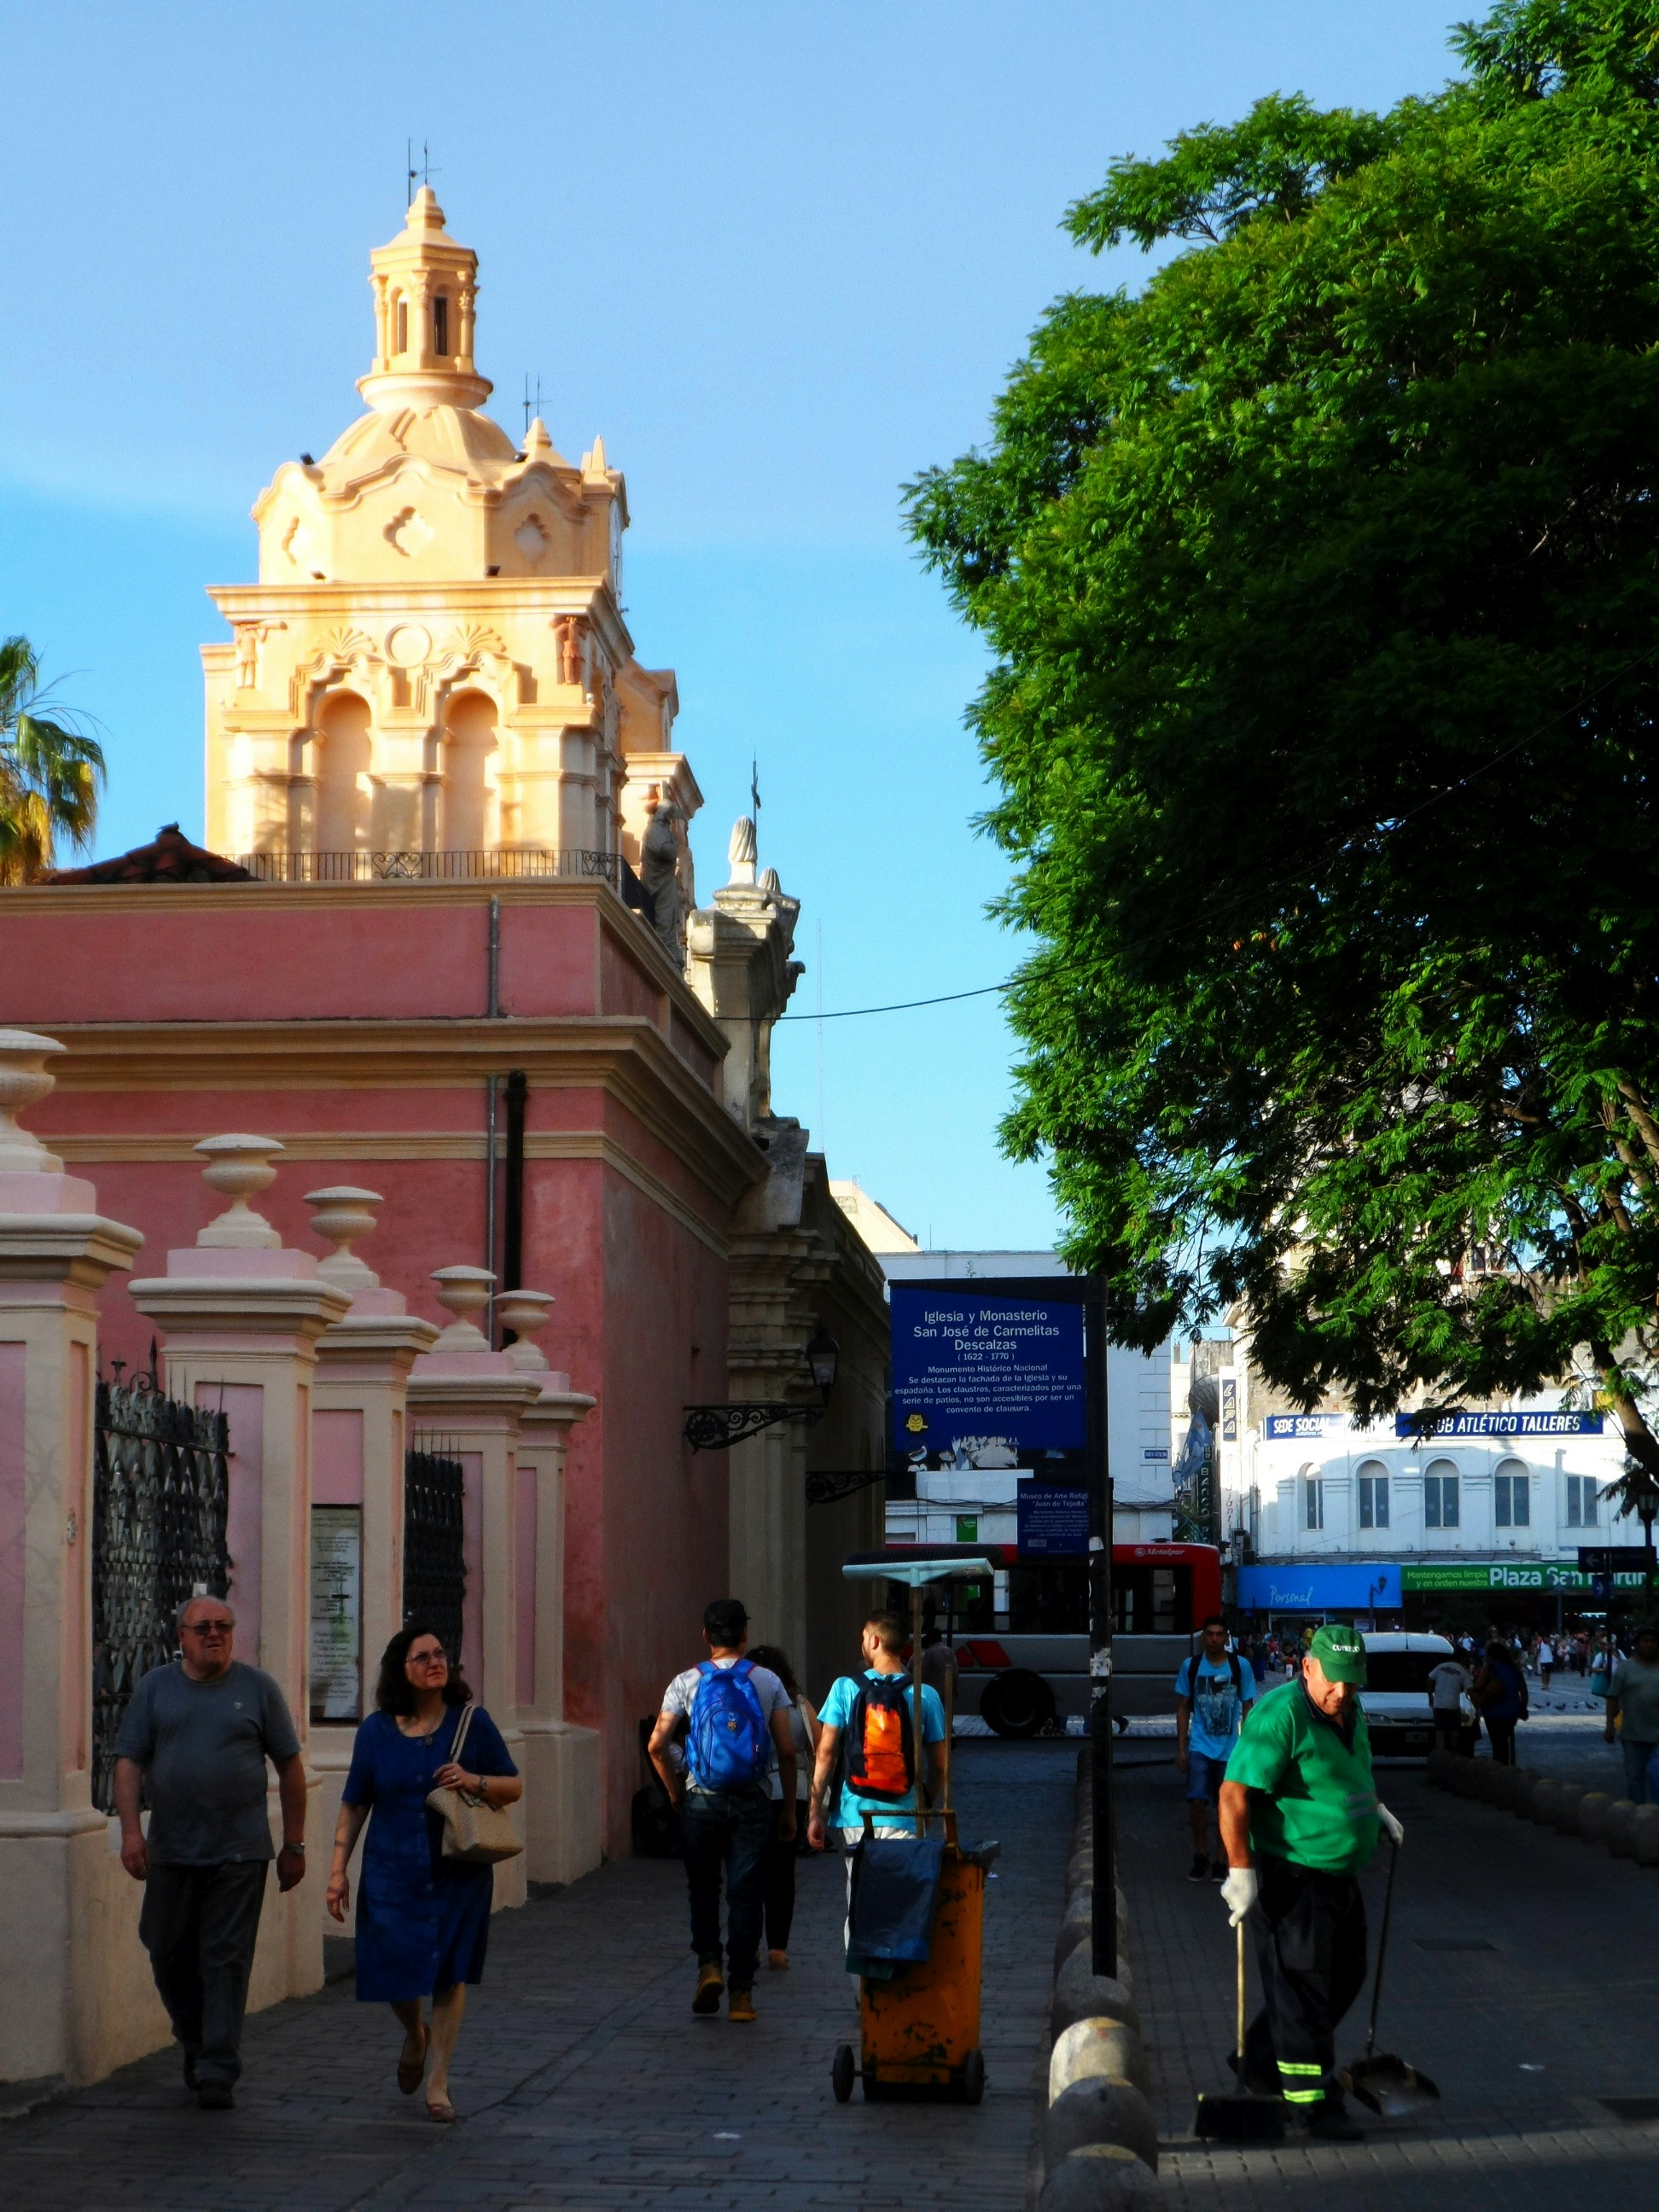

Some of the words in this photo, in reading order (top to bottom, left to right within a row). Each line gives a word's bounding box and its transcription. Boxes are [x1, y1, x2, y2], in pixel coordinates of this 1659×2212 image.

[925, 1311, 963, 1324] Iglesia
[969, 1313, 975, 1324] y
[981, 1310, 1047, 1320] Monasterio
[914, 1327, 936, 1336] San
[942, 1325, 969, 1336] José
[975, 1326, 988, 1336] de
[994, 1325, 1059, 1336] Carmelitas
[955, 1339, 1016, 1350] Descalzas
[1024, 1374, 1049, 1383] Iglesia
[895, 1387, 934, 1395] espadaña.
[993, 1384, 1049, 1393] caracterizados
[936, 1396, 961, 1406] patios,
[1223, 1384, 1235, 1434] LAPA
[1273, 1418, 1294, 1434] SEDE
[1295, 1417, 1330, 1433] SOCIAL
[1457, 1414, 1517, 1434] ATLÉTICO
[1522, 1415, 1580, 1433] TALLERES
[1407, 1570, 1463, 1580] Mantengamos
[1464, 1570, 1487, 1579] limpia
[1490, 1568, 1542, 1586] Plaza
[1546, 1567, 1586, 1586] San
[1270, 1586, 1313, 1605] Personal
